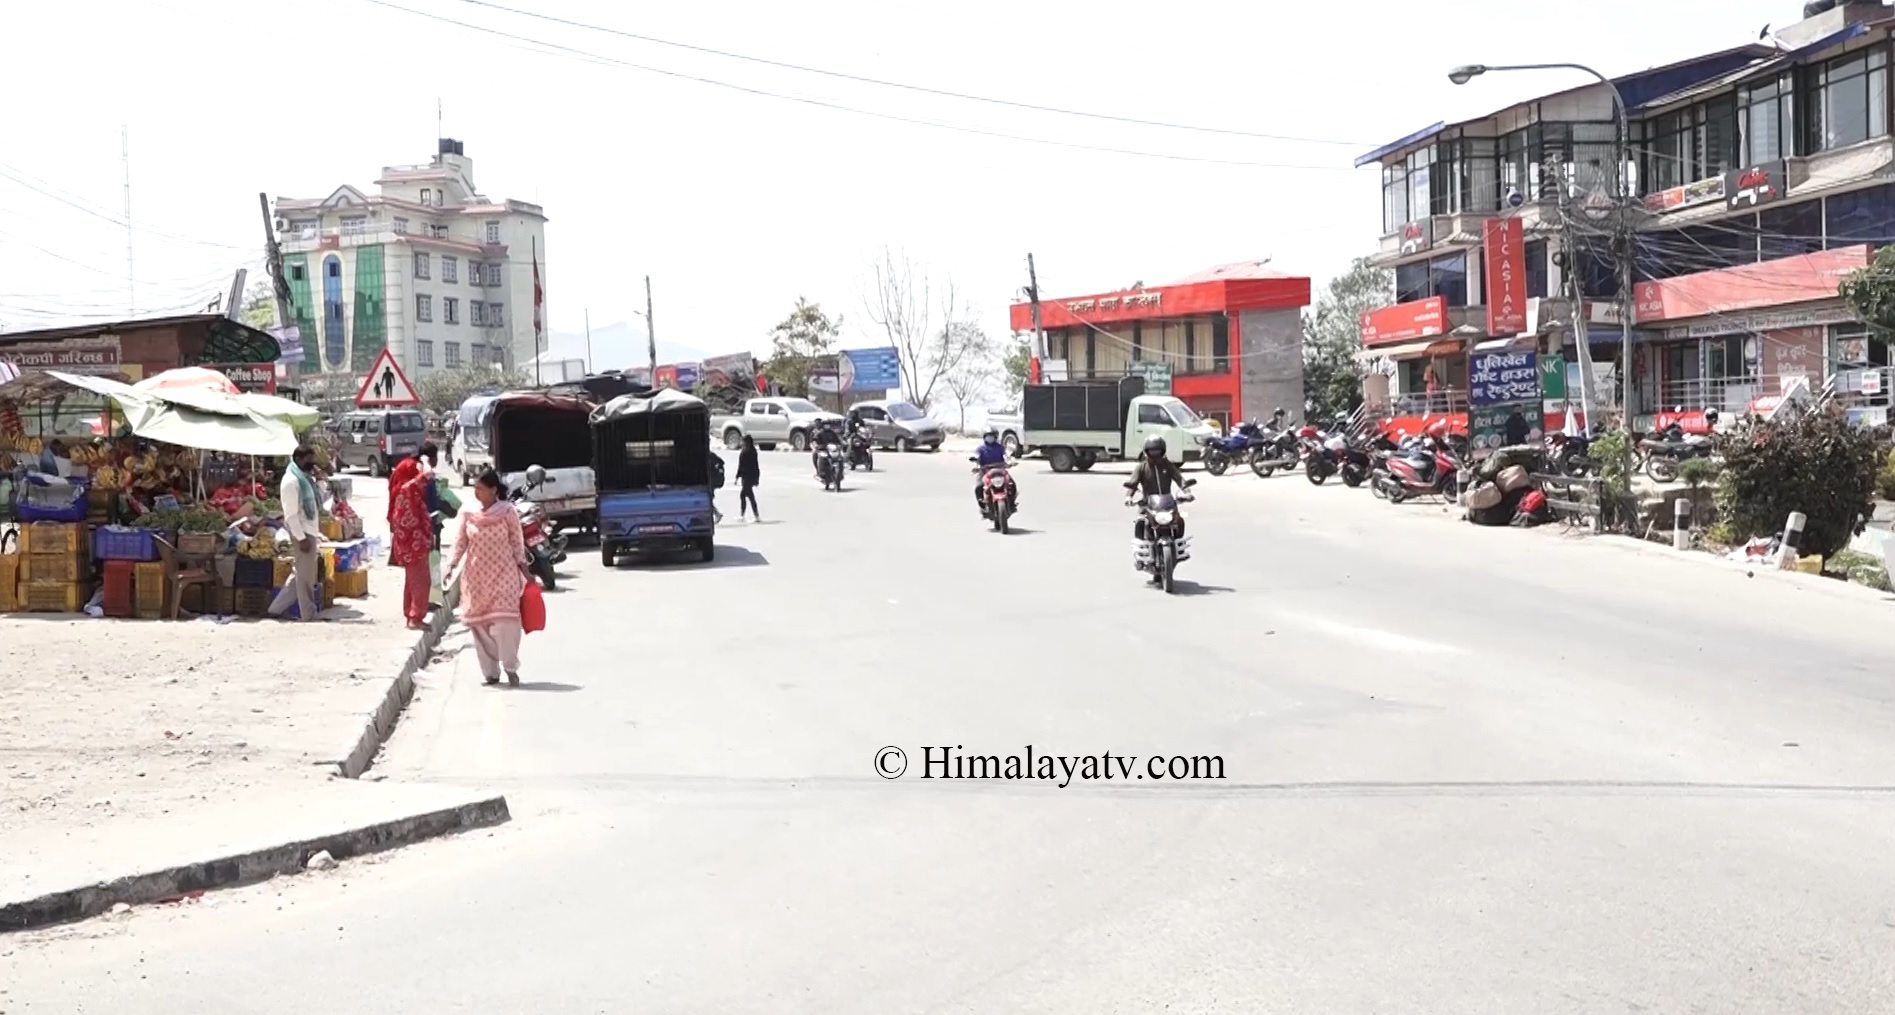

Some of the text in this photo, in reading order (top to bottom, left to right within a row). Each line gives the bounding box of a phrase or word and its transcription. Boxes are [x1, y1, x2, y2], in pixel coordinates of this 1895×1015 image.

[1500, 222, 1512, 303] NIC ASIA
[226, 367, 271, 382] Coffee Shop
